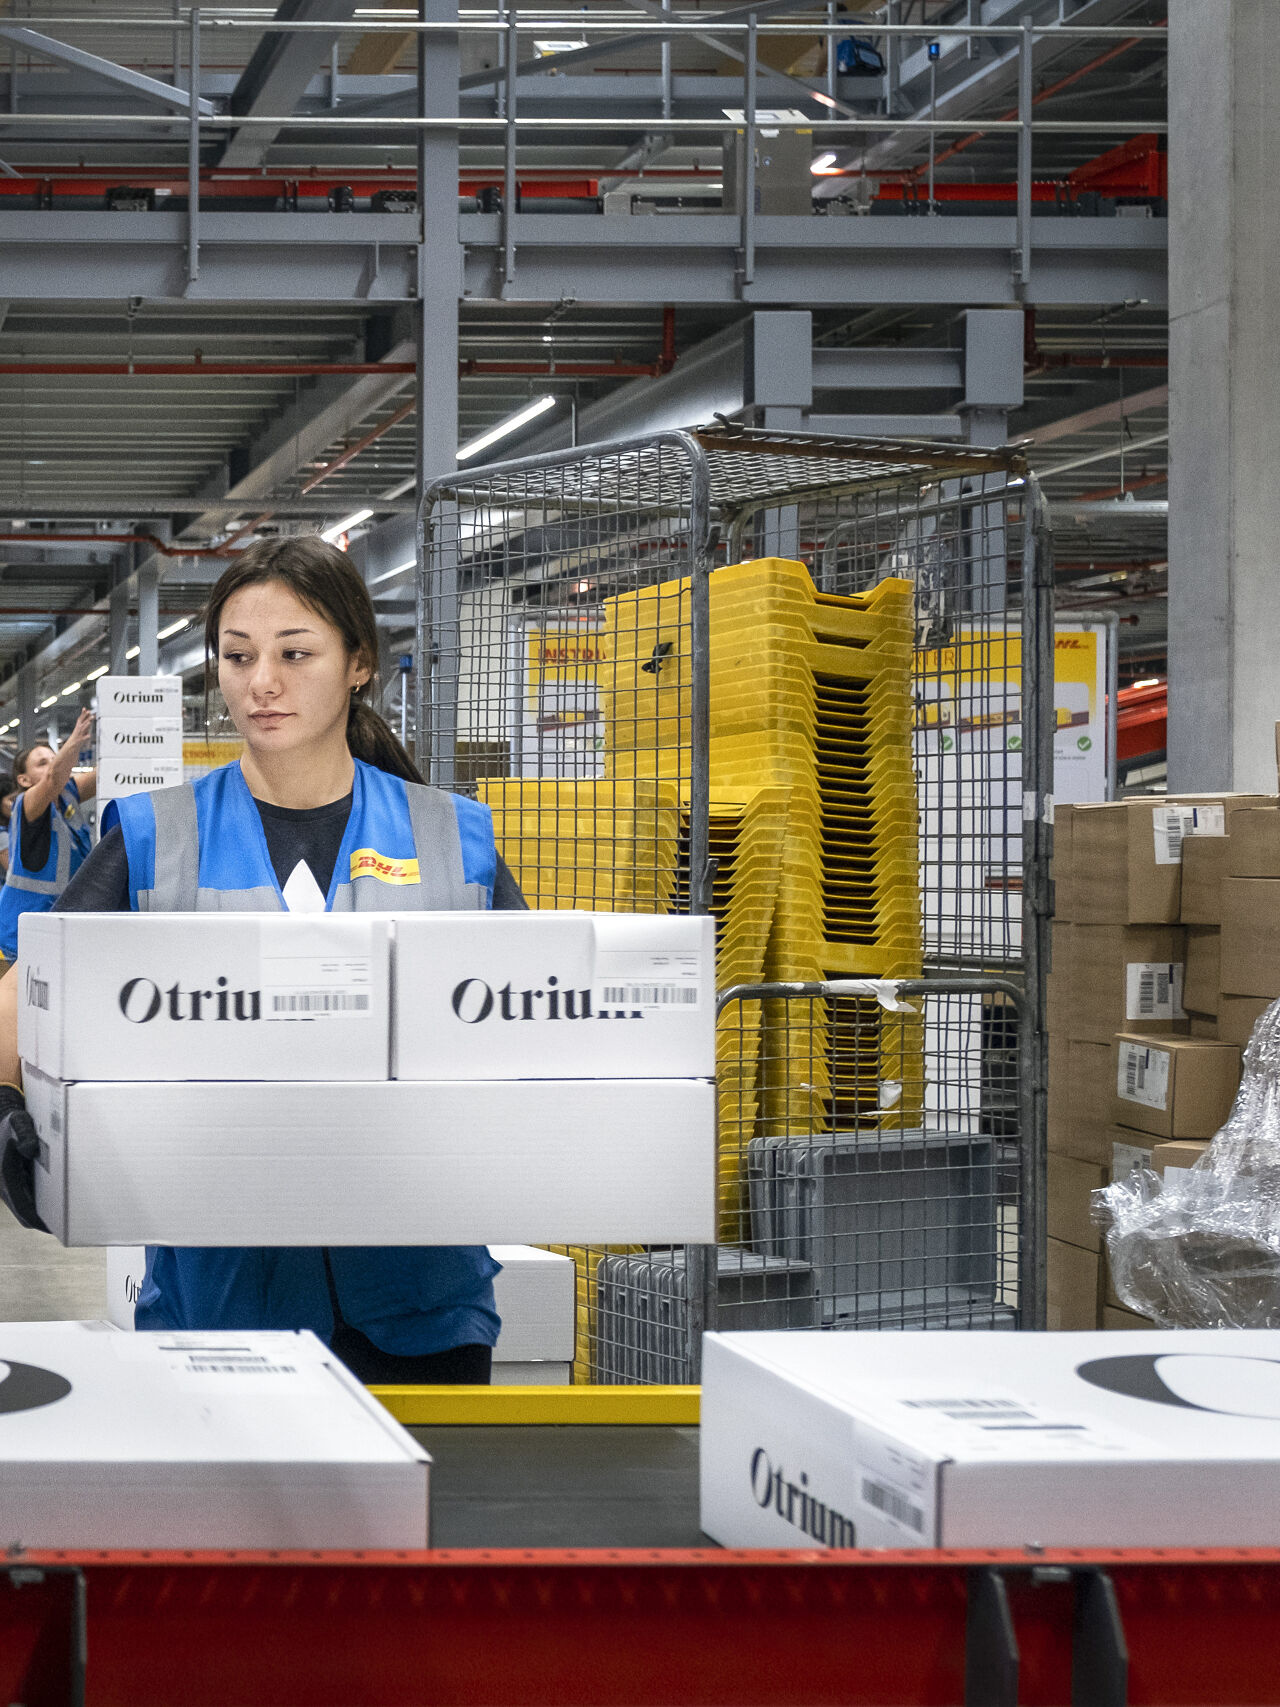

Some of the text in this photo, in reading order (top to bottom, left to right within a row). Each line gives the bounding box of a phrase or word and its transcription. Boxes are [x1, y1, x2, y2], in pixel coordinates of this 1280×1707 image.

[113, 690, 163, 703] Otrium
[113, 731, 163, 744] Otrium
[114, 772, 163, 785] Otrium
[358, 856, 408, 877] DHL
[118, 975, 316, 1024] Otriu
[451, 975, 645, 1024] Otriu
[750, 1447, 857, 1549] Otrium
